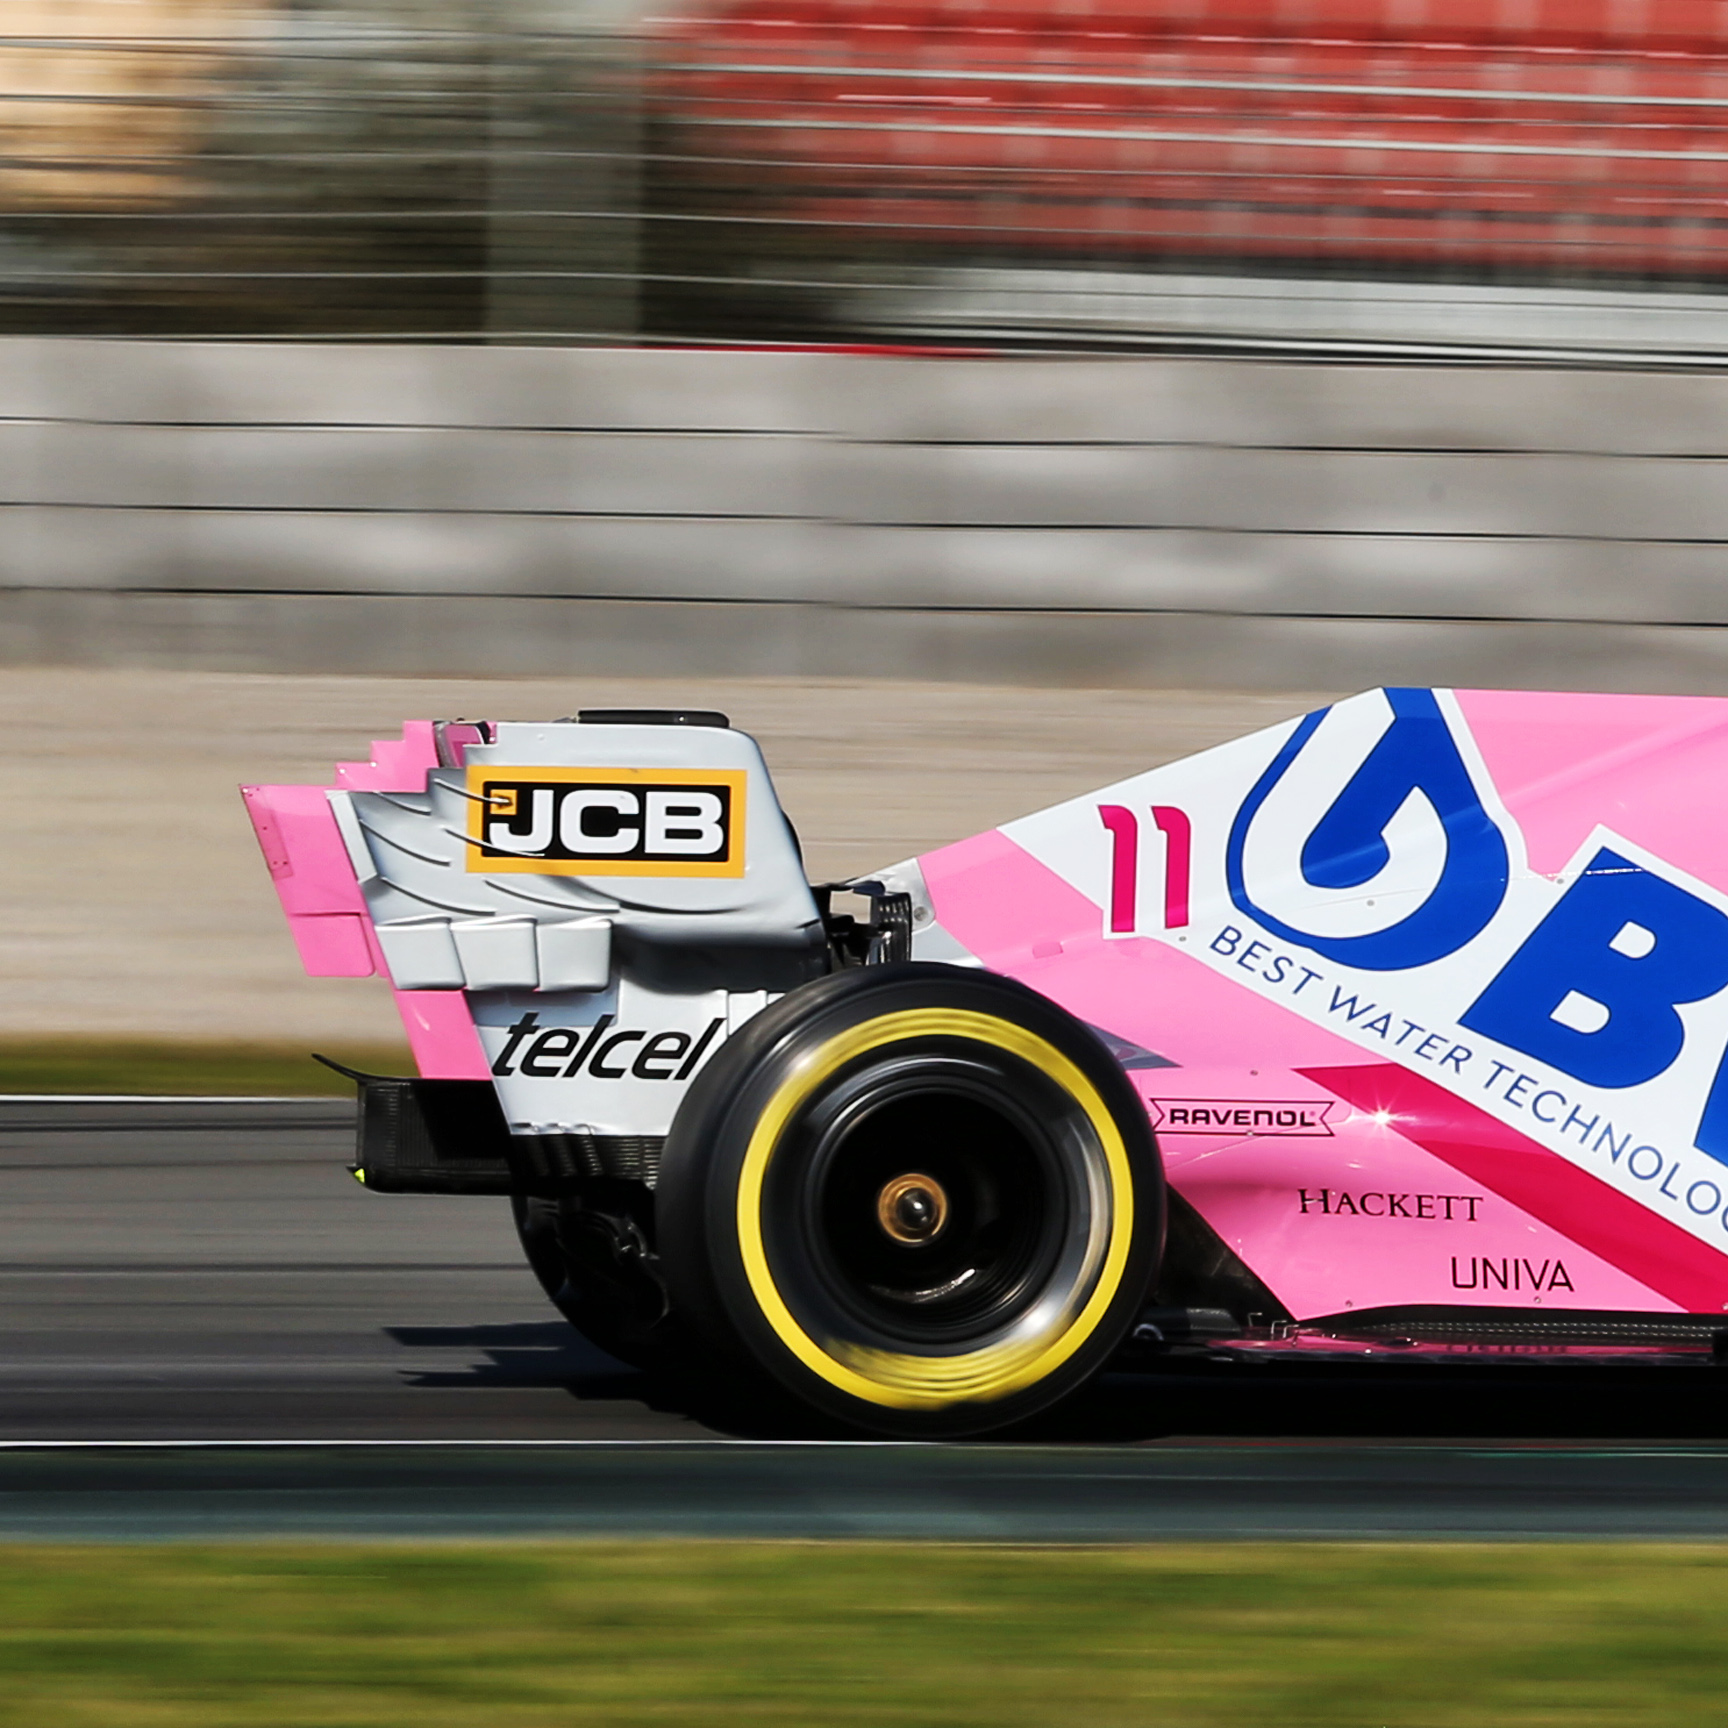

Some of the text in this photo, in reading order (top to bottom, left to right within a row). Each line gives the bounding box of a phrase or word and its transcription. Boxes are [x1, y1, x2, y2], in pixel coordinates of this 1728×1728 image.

[489, 789, 725, 855] JCB
[1097, 804, 1191, 933] 11
[1209, 925, 1324, 995] BEST
[1328, 985, 1473, 1076] WATER
[492, 1012, 728, 1081] telcel
[1169, 1108, 1316, 1127] RAVENOL
[1298, 1188, 1483, 1221] HACKETT
[1451, 1256, 1575, 1292] UNIVA
